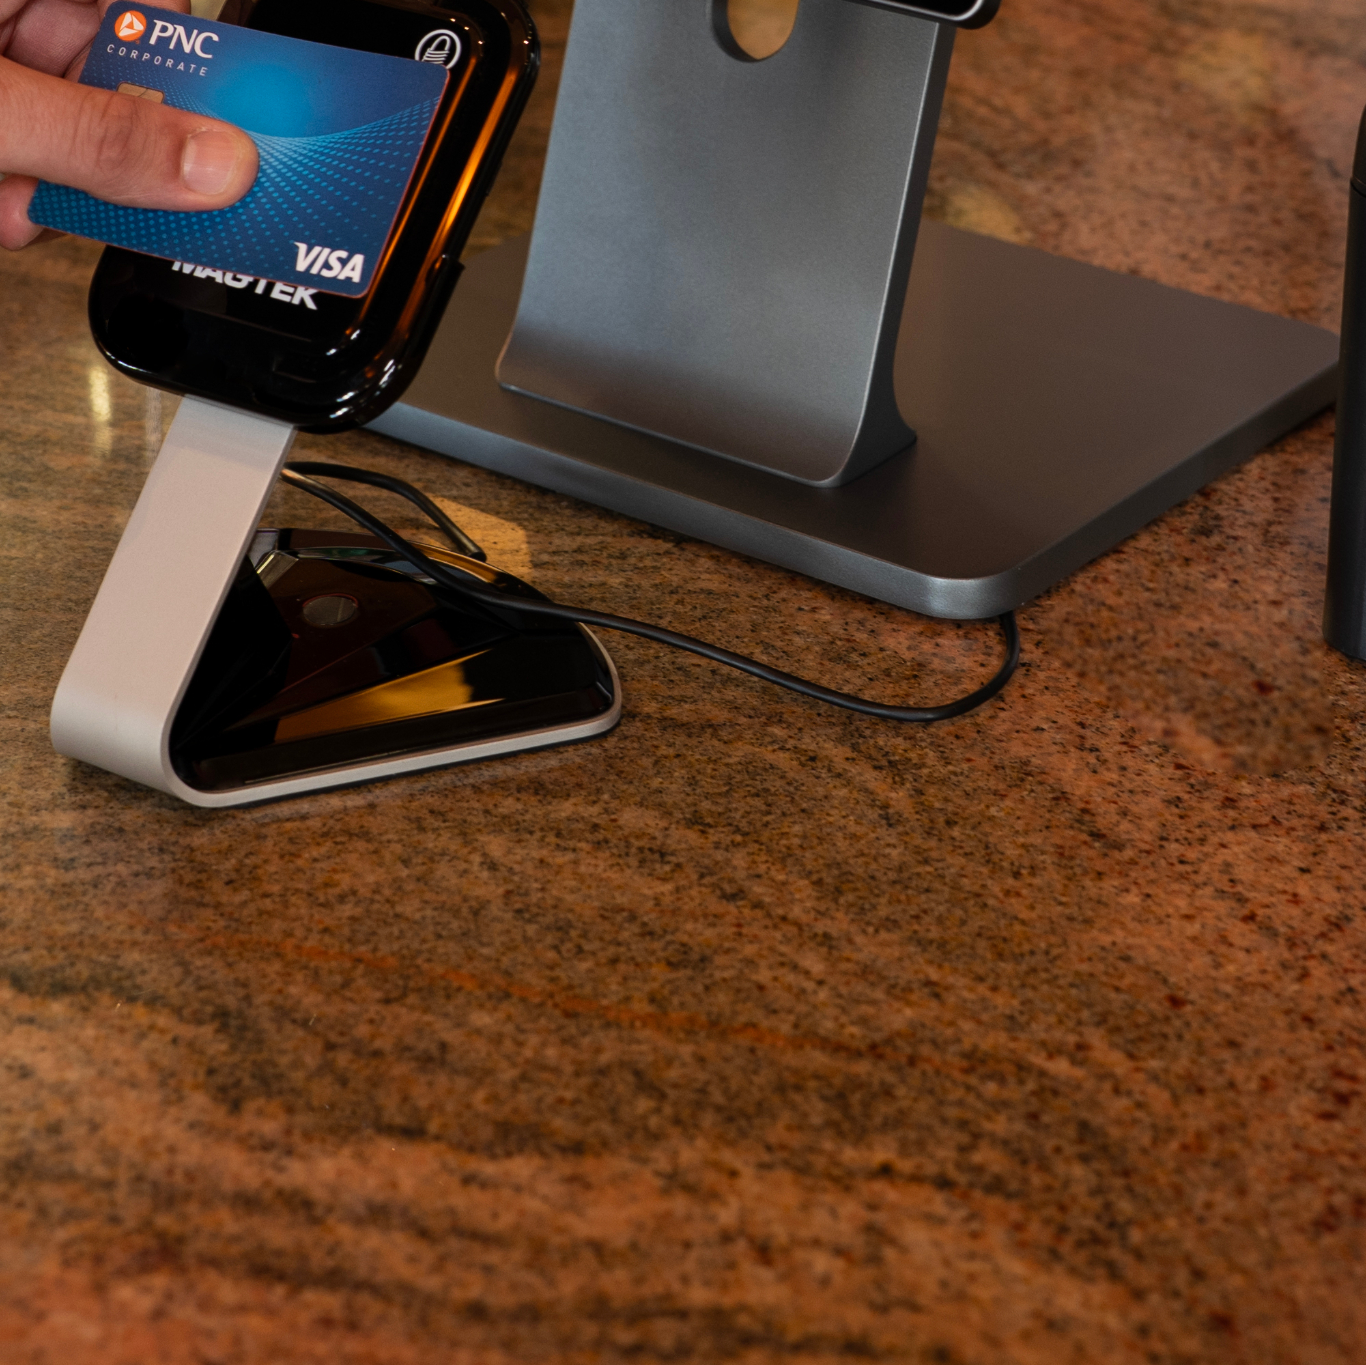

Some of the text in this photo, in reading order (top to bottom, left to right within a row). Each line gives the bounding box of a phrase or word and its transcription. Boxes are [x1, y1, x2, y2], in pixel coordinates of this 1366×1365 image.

[149, 19, 220, 59] PNC
[106, 44, 208, 77] CORPORATE
[293, 241, 366, 283] VISA
